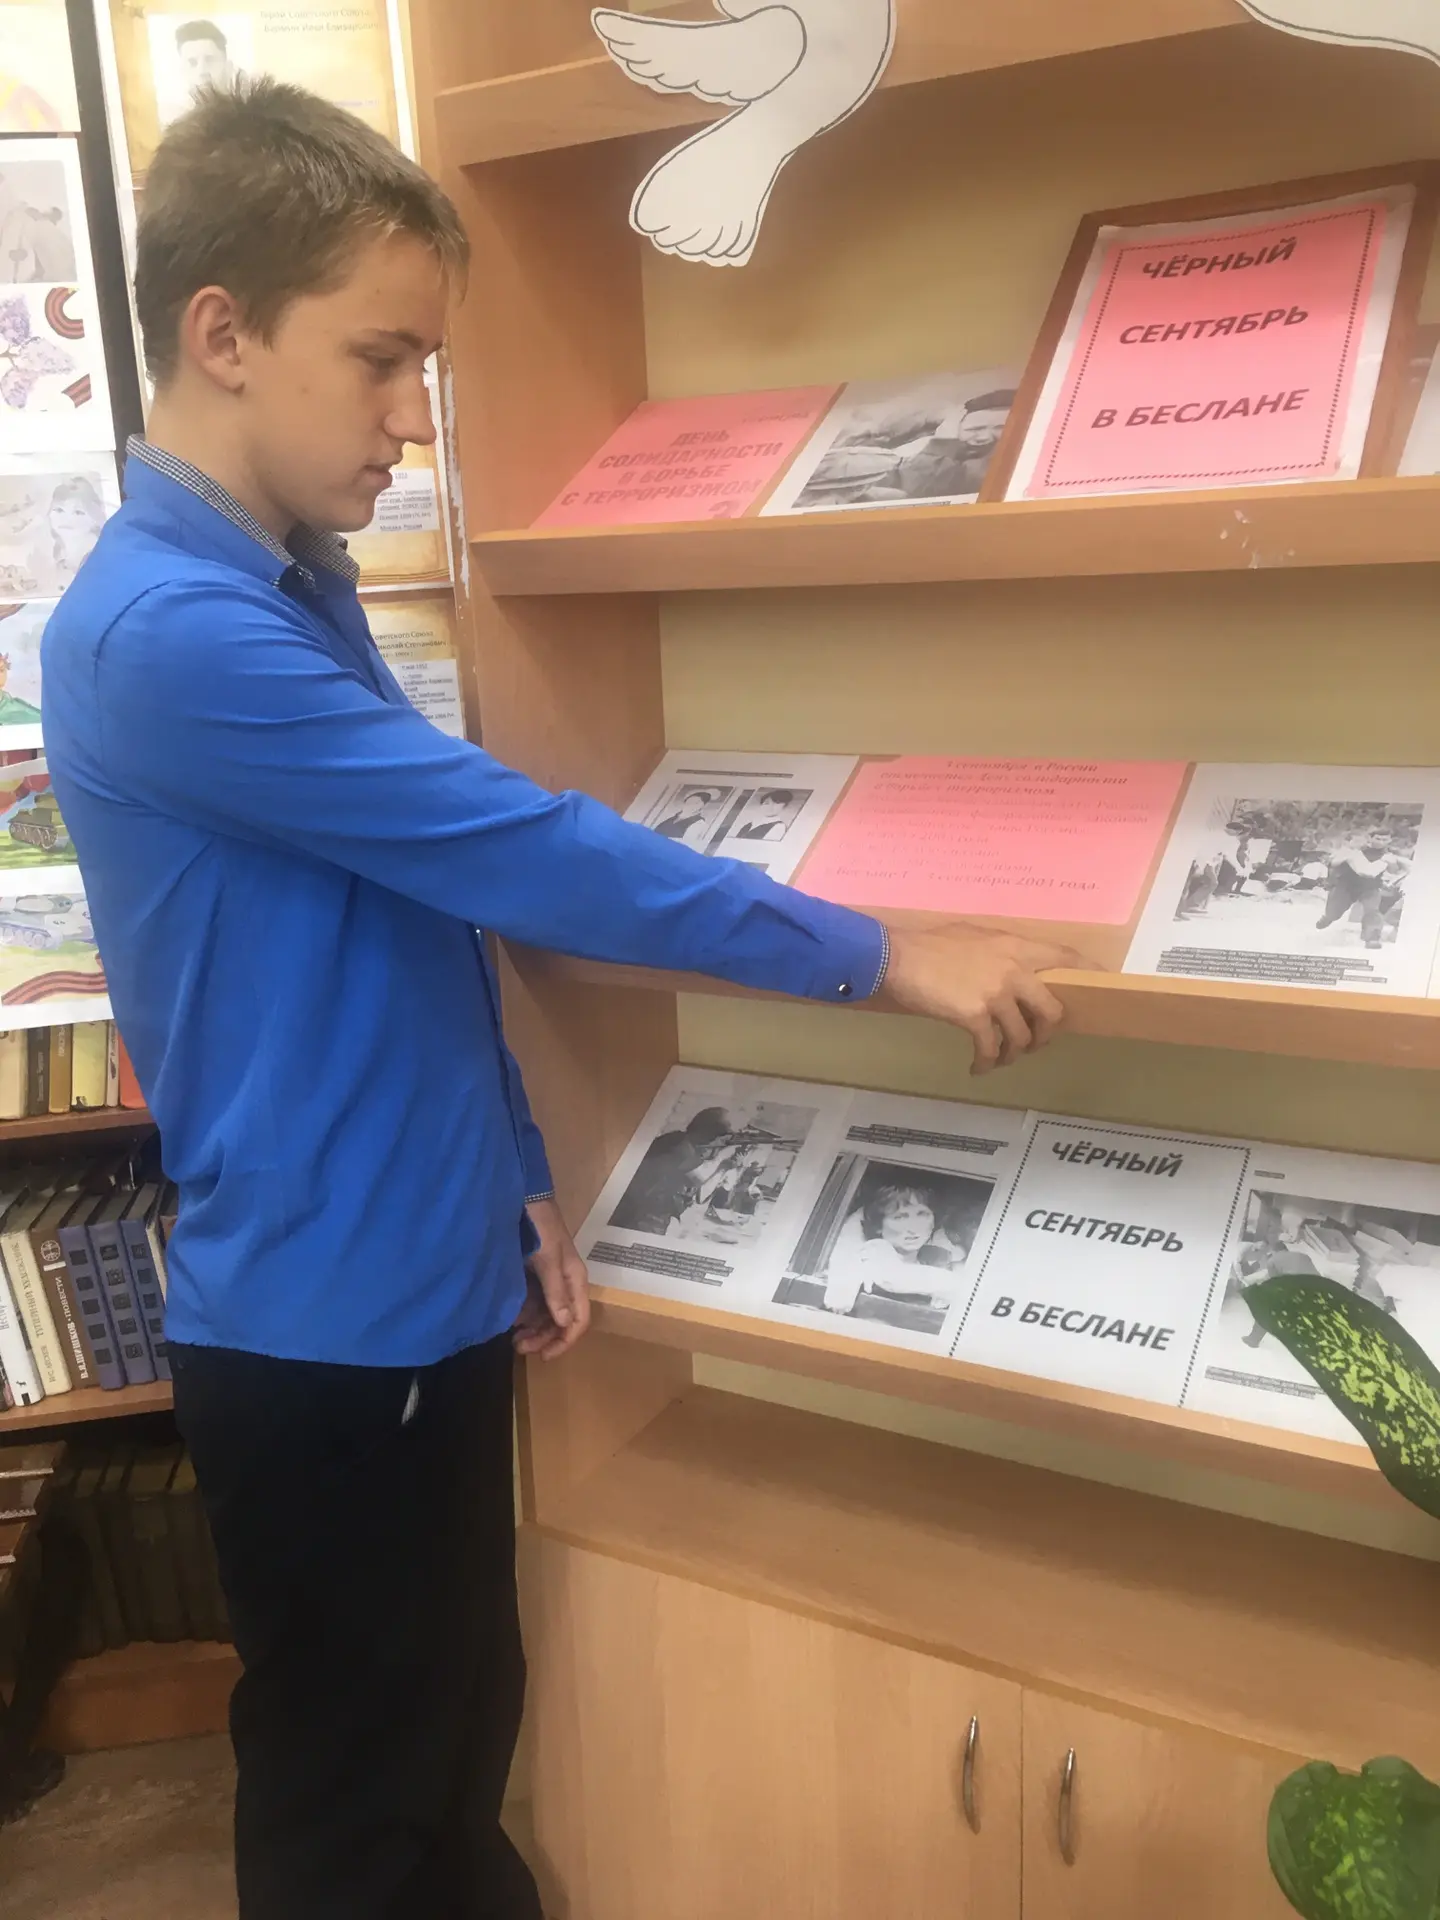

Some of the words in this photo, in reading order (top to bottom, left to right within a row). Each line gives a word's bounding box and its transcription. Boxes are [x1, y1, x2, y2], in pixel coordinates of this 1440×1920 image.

[1143, 236, 1297, 279] ЧЁРНЫЙ
[1119, 306, 1309, 345] СЕНТЯБРЬ
[1091, 409, 1118, 429] В
[1125, 388, 1310, 427] БЕСЛАНЕ
[669, 429, 730, 447] ДЕНЬ
[598, 441, 783, 470] СОЛИДАРНОСТИ
[639, 463, 732, 484] БОРЬБЕ
[560, 491, 577, 506] С
[583, 478, 762, 505] ТЕРРОРИЗМОМ
[376, 642, 404, 651] иколай
[955, 761, 1027, 772] сентября
[1046, 762, 1098, 773] России
[1014, 773, 1128, 786] солидарности
[1052, 1141, 1183, 1178] ЧЁРНЫЙ
[1024, 1209, 1183, 1253] СЕНТЯБРЬ
[55, 1276, 72, 1319] ПОВЕСТИ
[990, 1296, 1015, 1318] В
[1019, 1302, 1175, 1351] БЕСЛАНЕ
